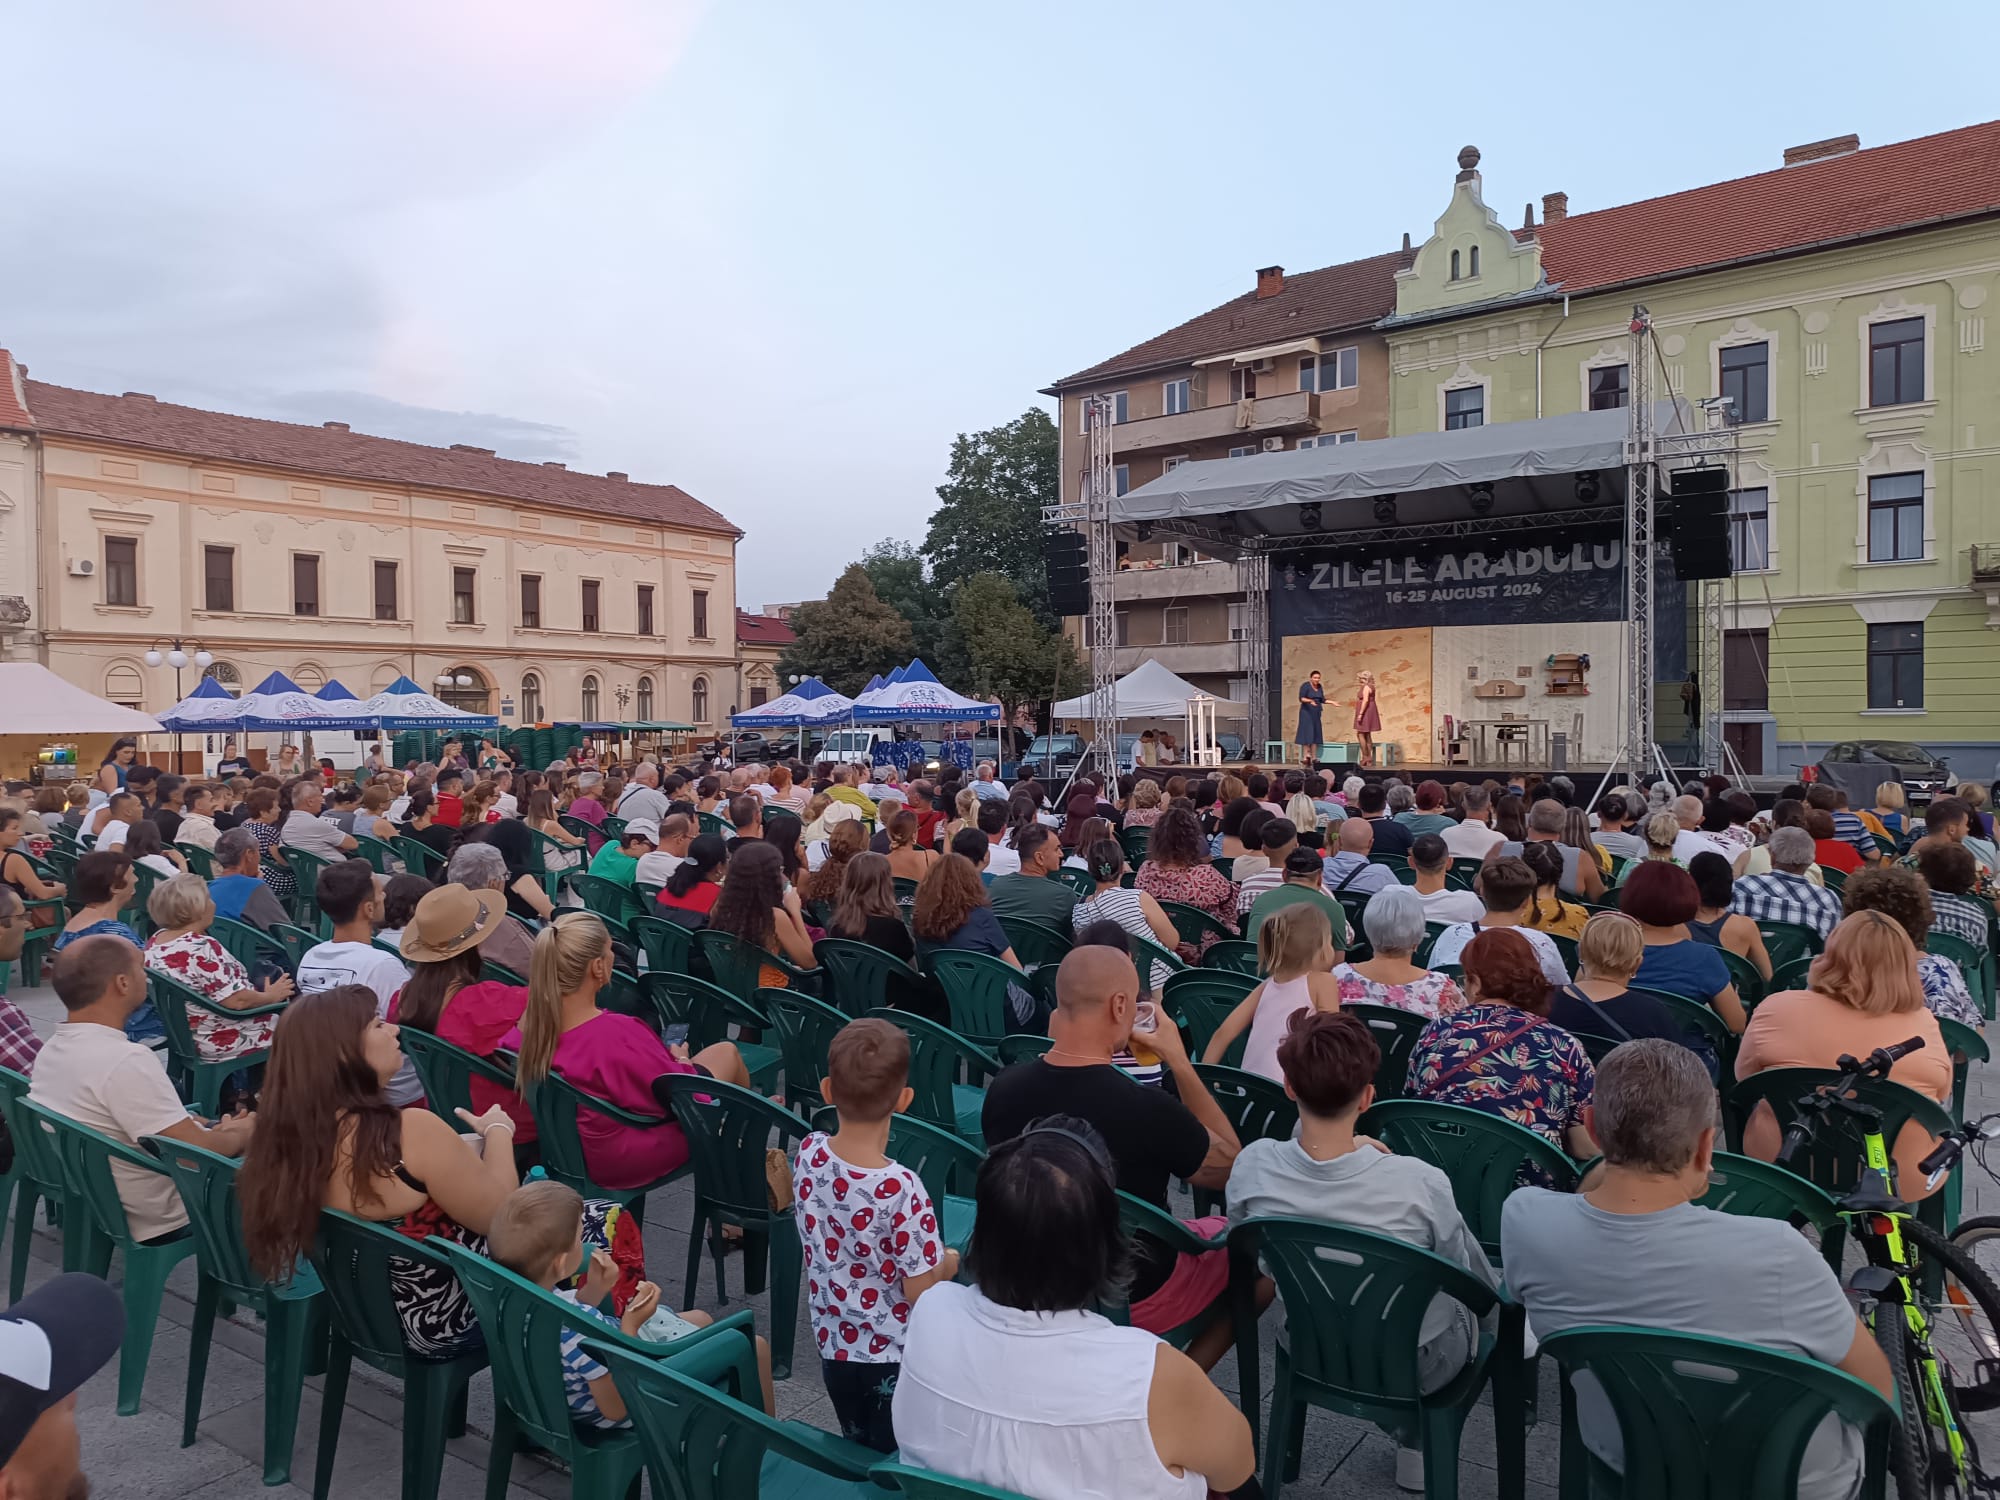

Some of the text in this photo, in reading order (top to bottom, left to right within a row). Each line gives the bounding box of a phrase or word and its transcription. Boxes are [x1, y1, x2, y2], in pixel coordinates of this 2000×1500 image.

[1309, 556, 1426, 590] ZILELE
[1385, 582, 1543, 604] 16-25 AUGUST 2024
